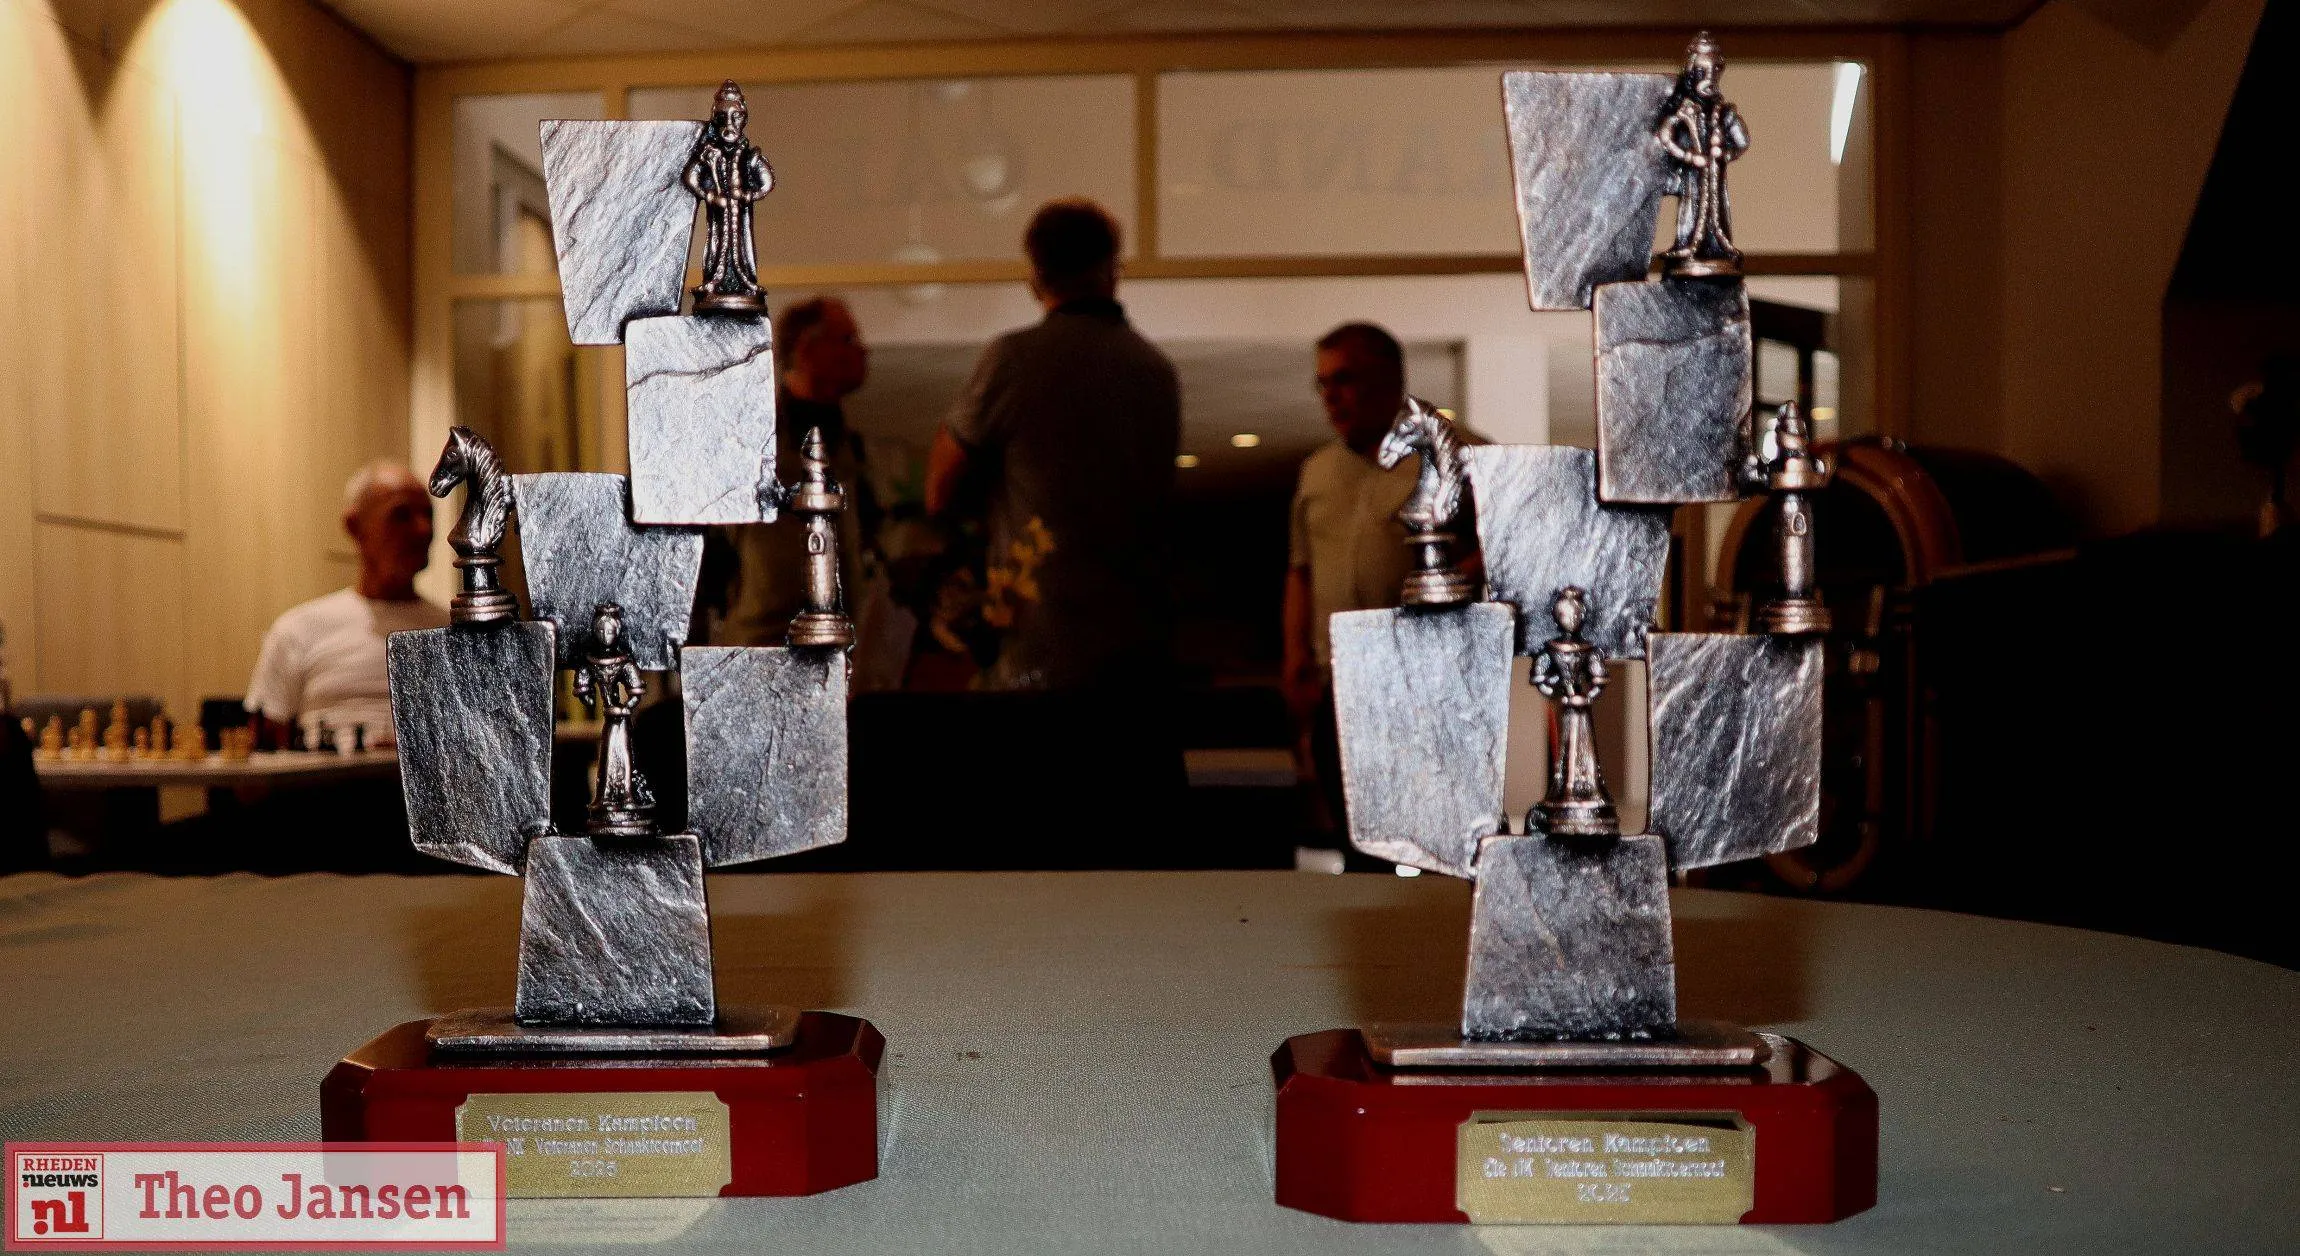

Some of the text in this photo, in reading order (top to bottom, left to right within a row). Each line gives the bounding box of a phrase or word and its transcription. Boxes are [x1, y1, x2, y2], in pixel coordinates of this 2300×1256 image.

[487, 1113, 698, 1134] Veteranen Kampioen
[569, 1159, 619, 1178] 2025
